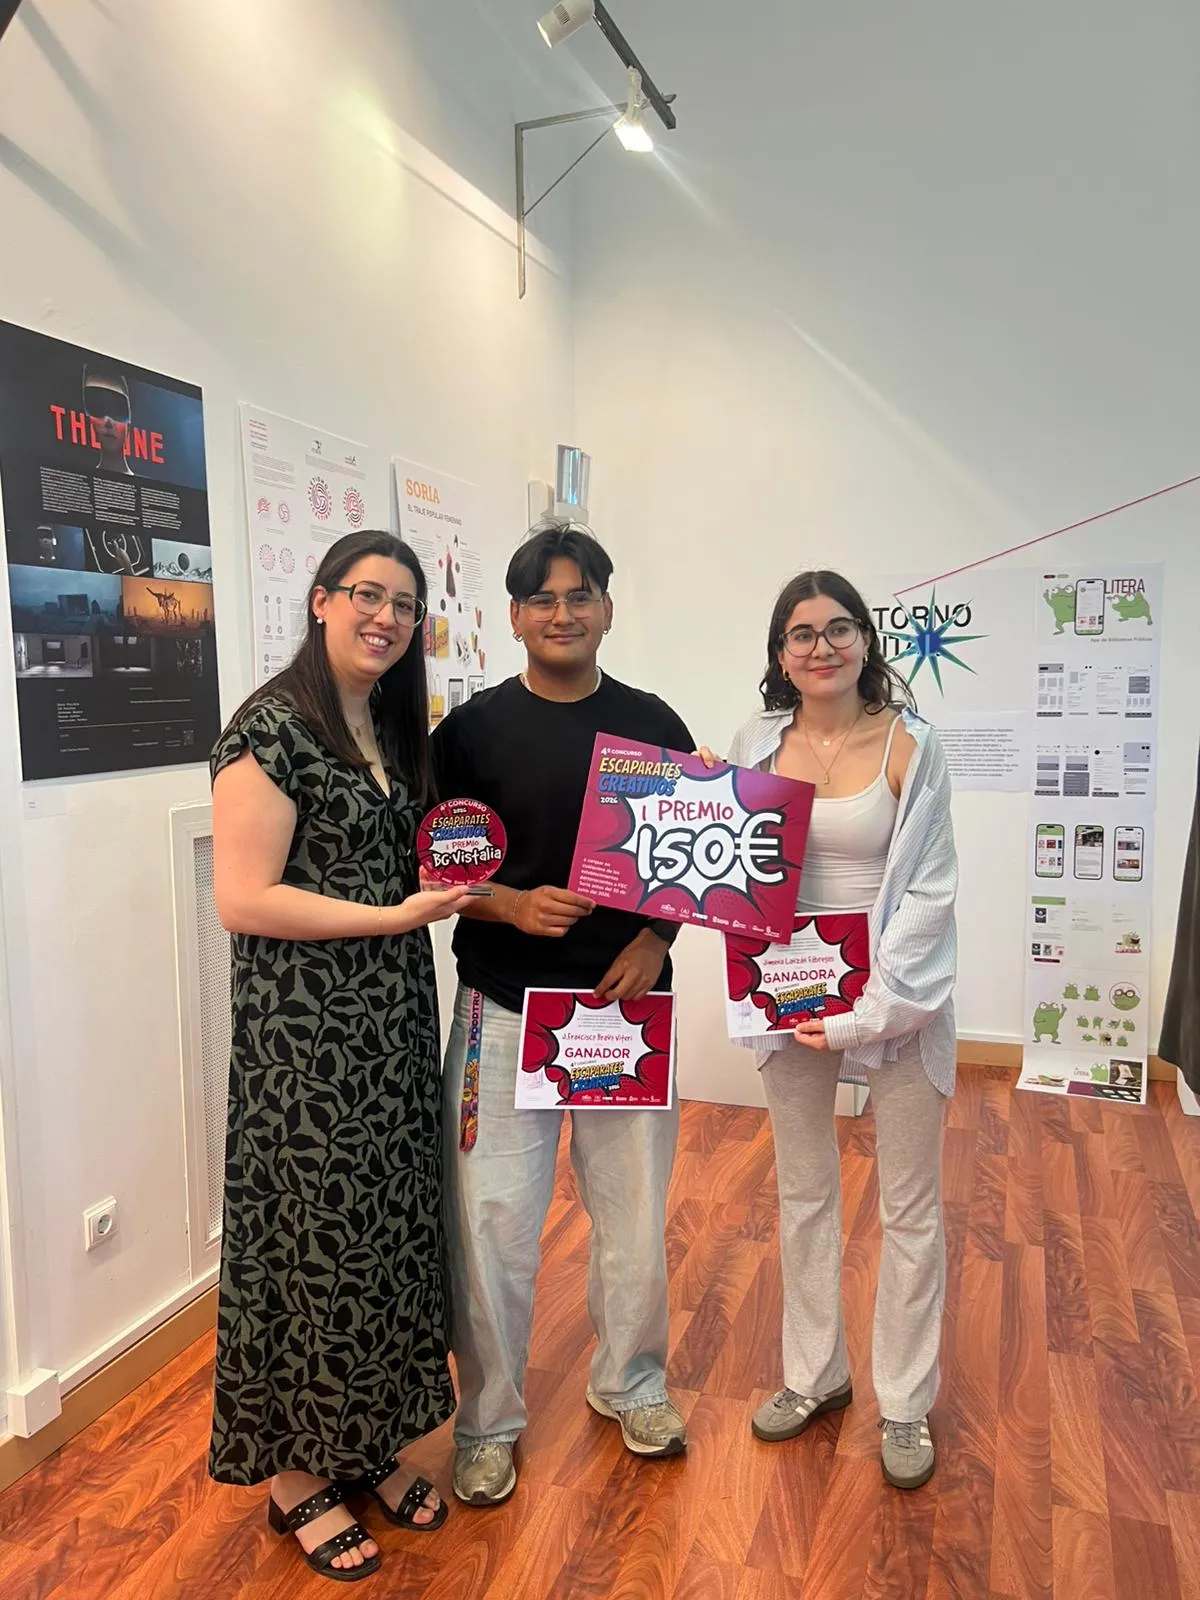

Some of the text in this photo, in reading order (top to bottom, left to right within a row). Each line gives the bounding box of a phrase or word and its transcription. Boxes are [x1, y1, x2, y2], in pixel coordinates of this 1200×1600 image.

[49, 404, 104, 449] THE
[405, 478, 440, 504] SORIA
[1104, 578, 1146, 594] LITERA
[600, 747, 611, 756] 4º
[599, 757, 683, 779] ESCAPARATES
[598, 774, 678, 797] CREATIVOS
[448, 800, 487, 812] CONCURSO
[600, 796, 618, 804] 2026
[658, 800, 734, 822] PREMIO
[432, 813, 491, 828] ESCAPARATES
[433, 827, 487, 841] CREATIVOS
[452, 840, 480, 849] PREMIO
[637, 811, 786, 885] 150€
[763, 968, 836, 984] GANADORA
[776, 982, 827, 1004] ESCAPARATES
[564, 1047, 630, 1058] GANADOR
[570, 1061, 624, 1080] ESCAPARATES
